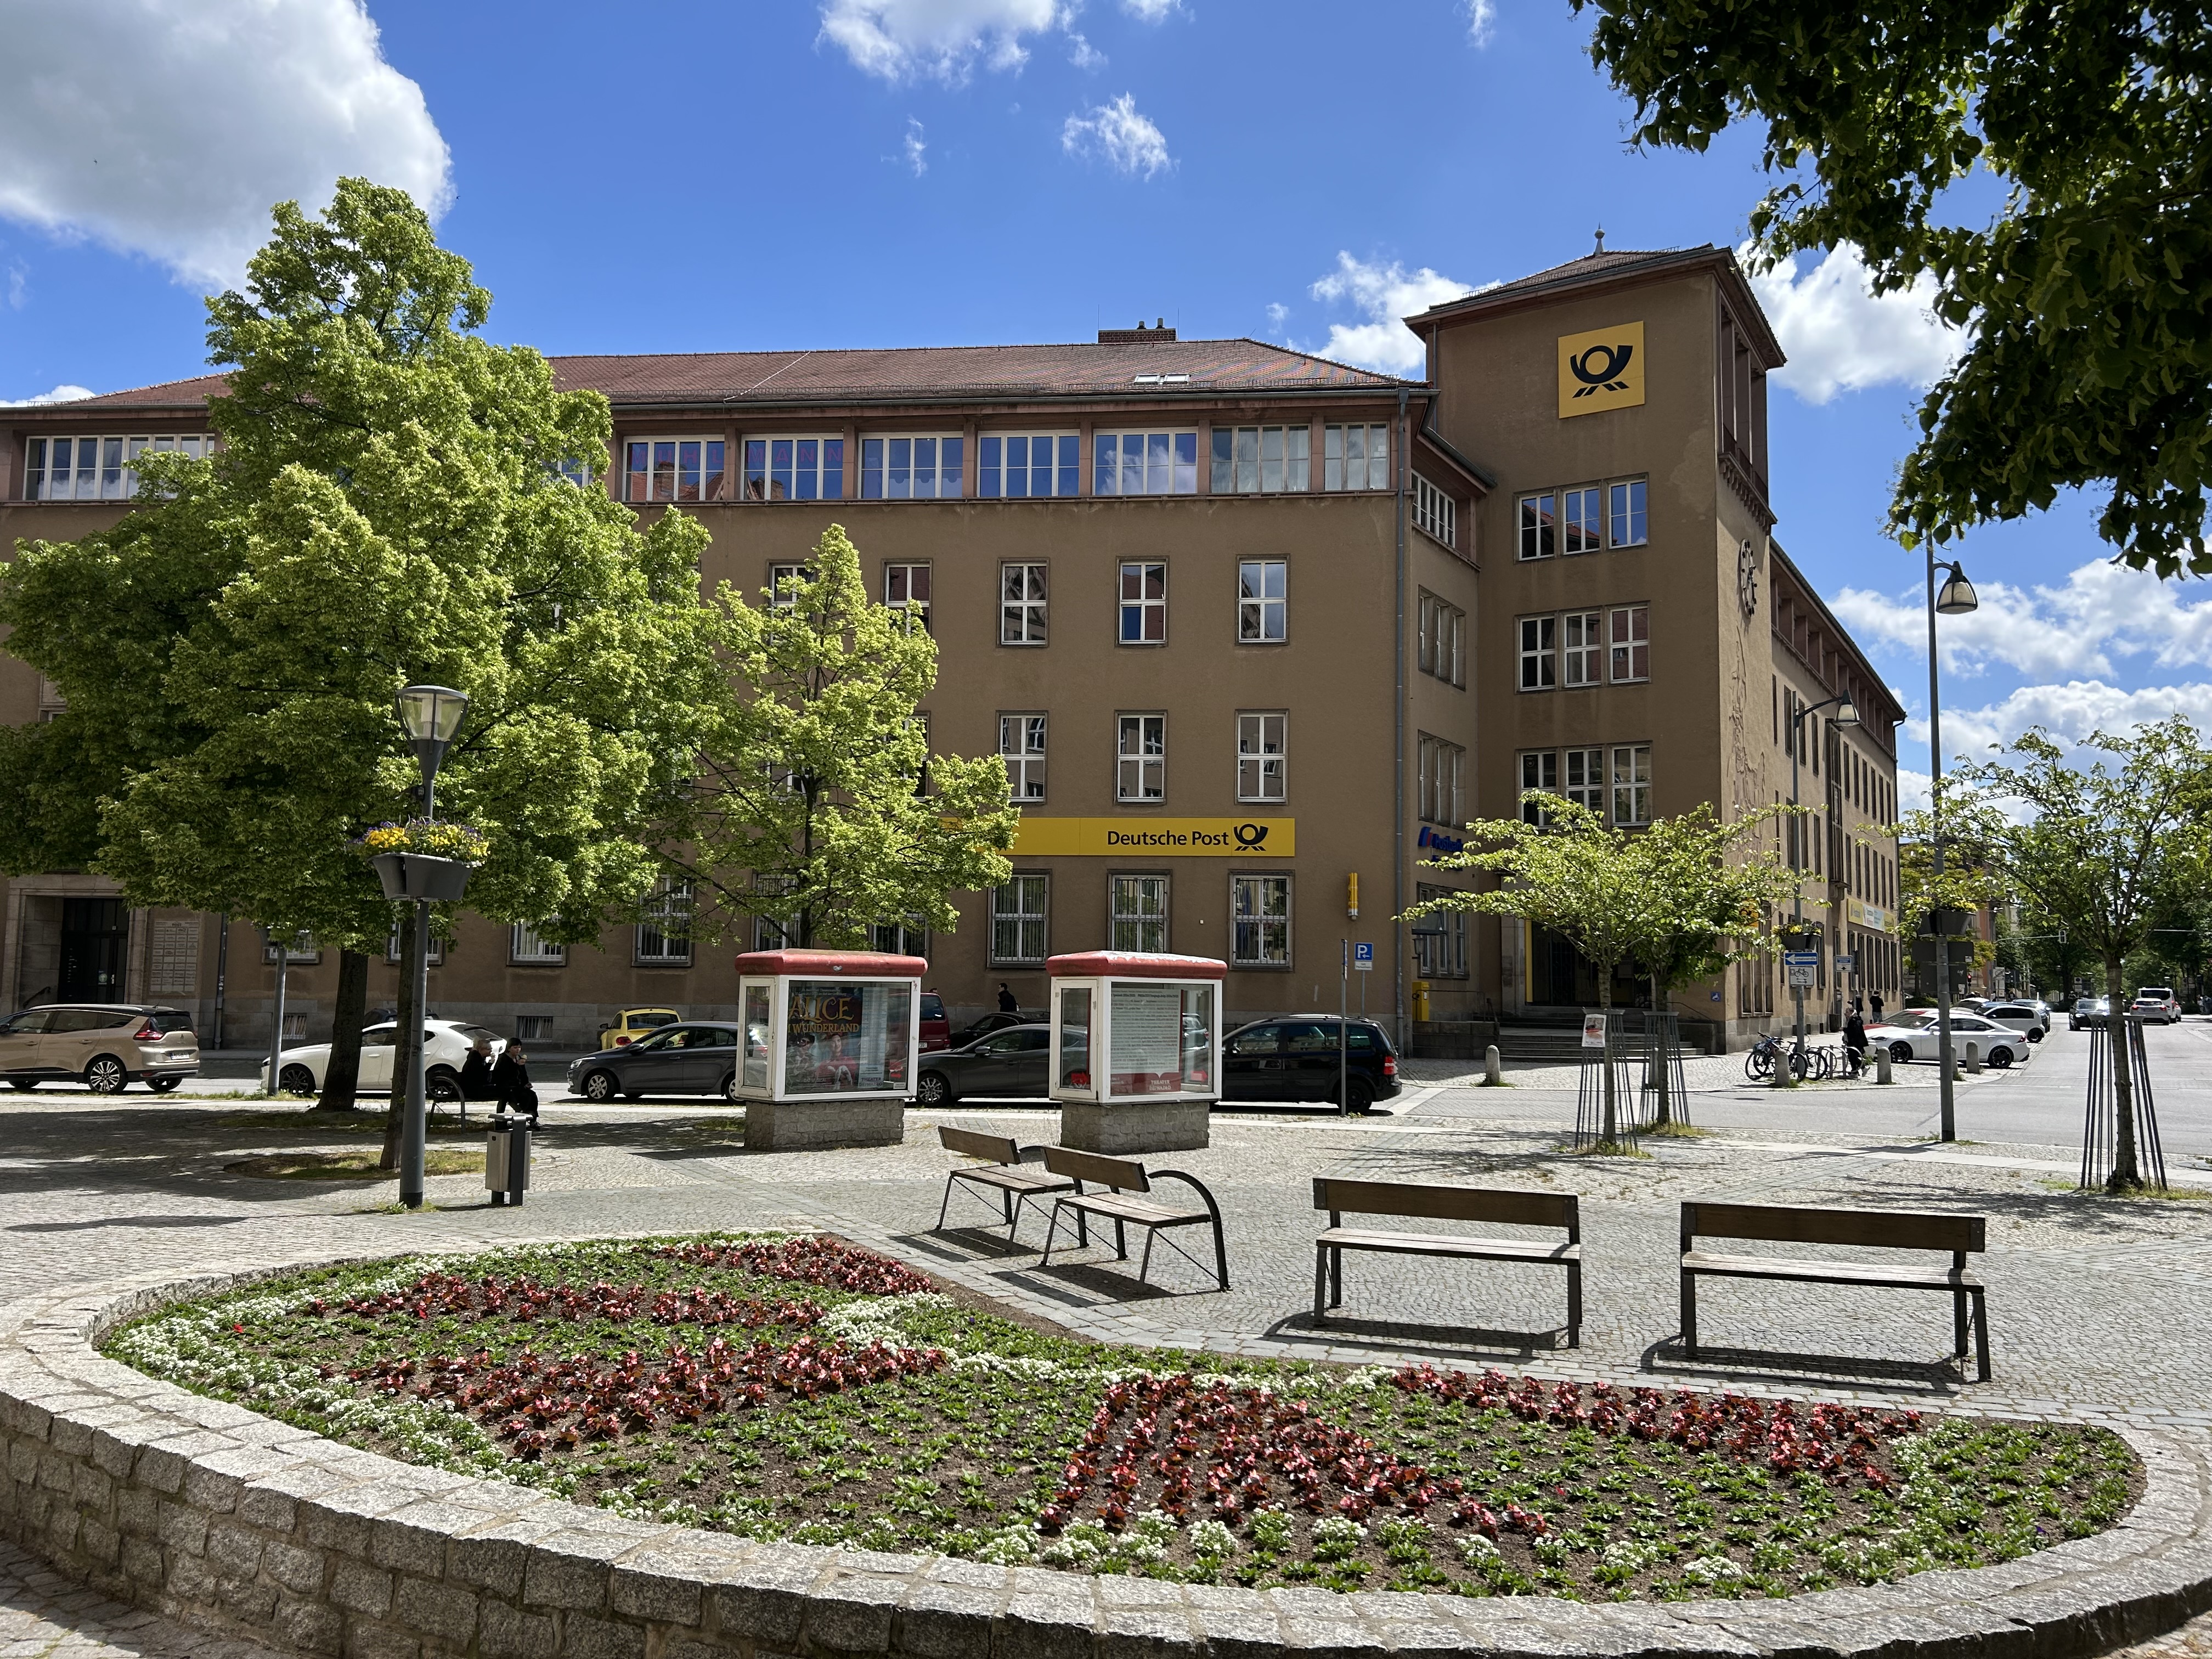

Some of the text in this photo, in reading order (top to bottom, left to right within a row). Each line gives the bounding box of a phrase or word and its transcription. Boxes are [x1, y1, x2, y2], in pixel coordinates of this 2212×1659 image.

[1108, 830, 1229, 845] Deutsche Post
[1357, 944, 1368, 958] P
[788, 996, 854, 1023] ALICE
[793, 1023, 860, 1033] WUNDERLAND
